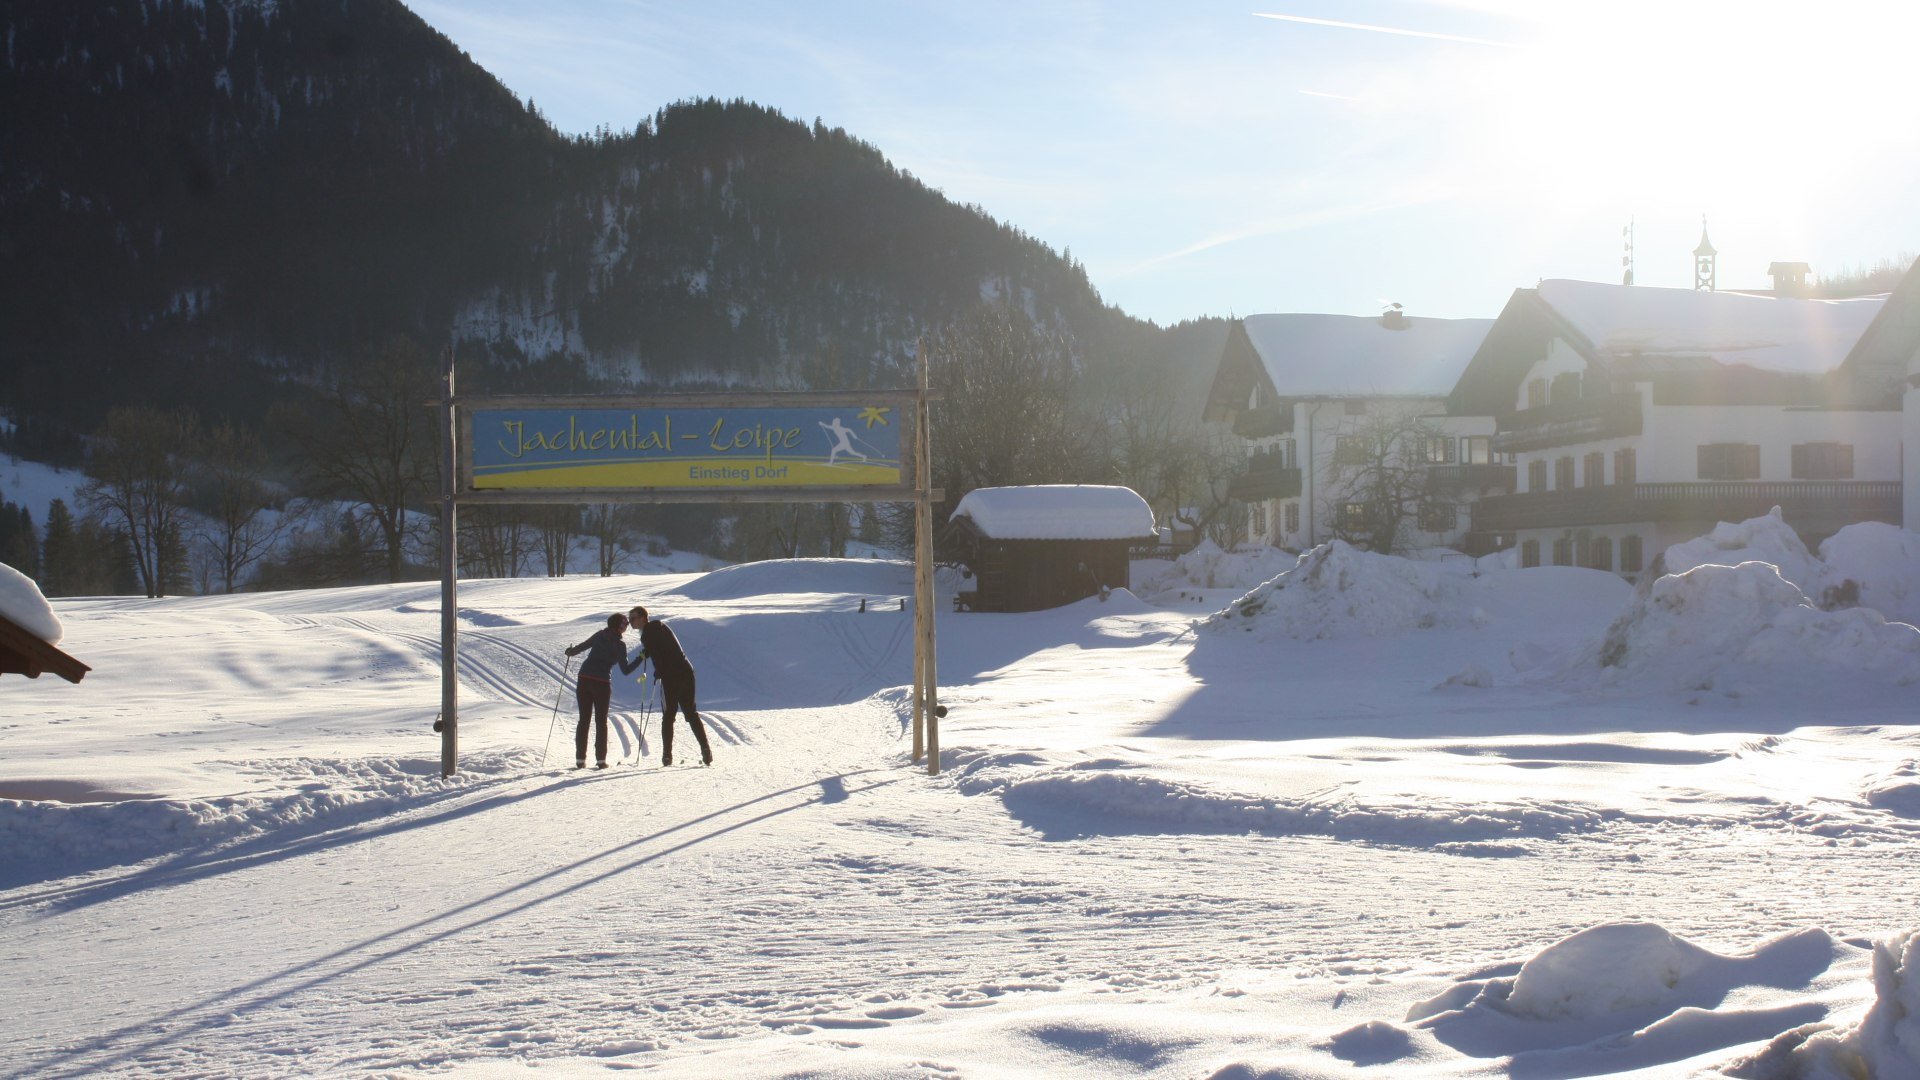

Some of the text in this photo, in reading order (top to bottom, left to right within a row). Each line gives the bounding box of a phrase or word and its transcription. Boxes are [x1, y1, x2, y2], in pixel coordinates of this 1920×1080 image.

[498, 414, 672, 457] Jachental
[708, 417, 802, 467] Loipe
[689, 466, 788, 480] Einstieg Dorf
